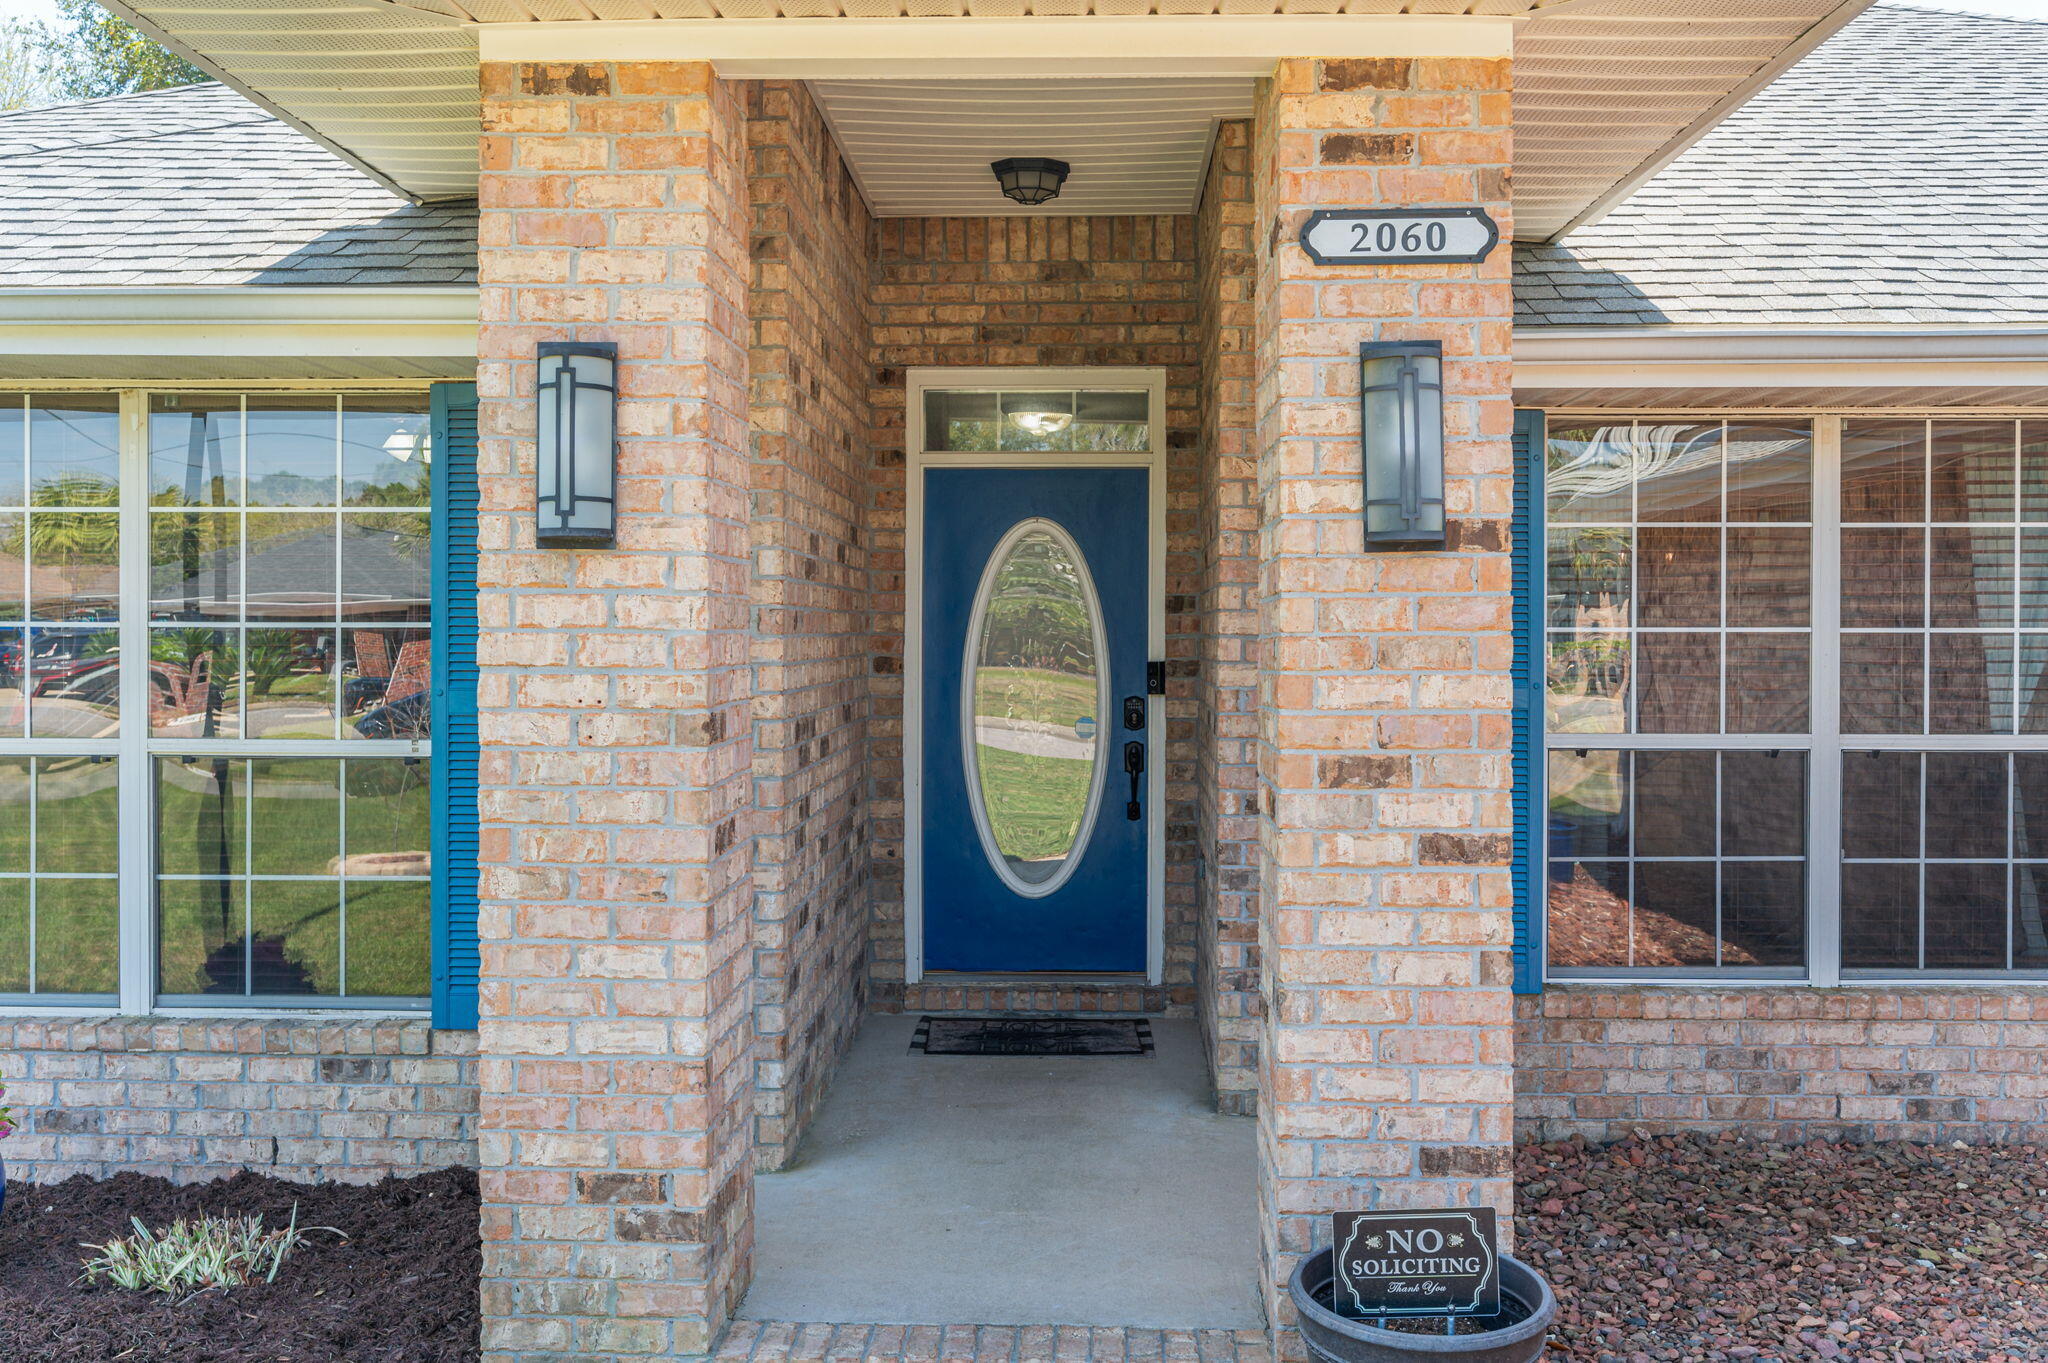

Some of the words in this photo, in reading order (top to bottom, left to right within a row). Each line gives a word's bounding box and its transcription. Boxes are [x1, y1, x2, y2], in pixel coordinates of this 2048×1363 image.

[1349, 221, 1447, 253] 2060
[1386, 1228, 1444, 1254] NO
[1352, 1257, 1481, 1276] SOLICITING
[1387, 1281, 1420, 1294] Thank
[1422, 1281, 1447, 1295] You
